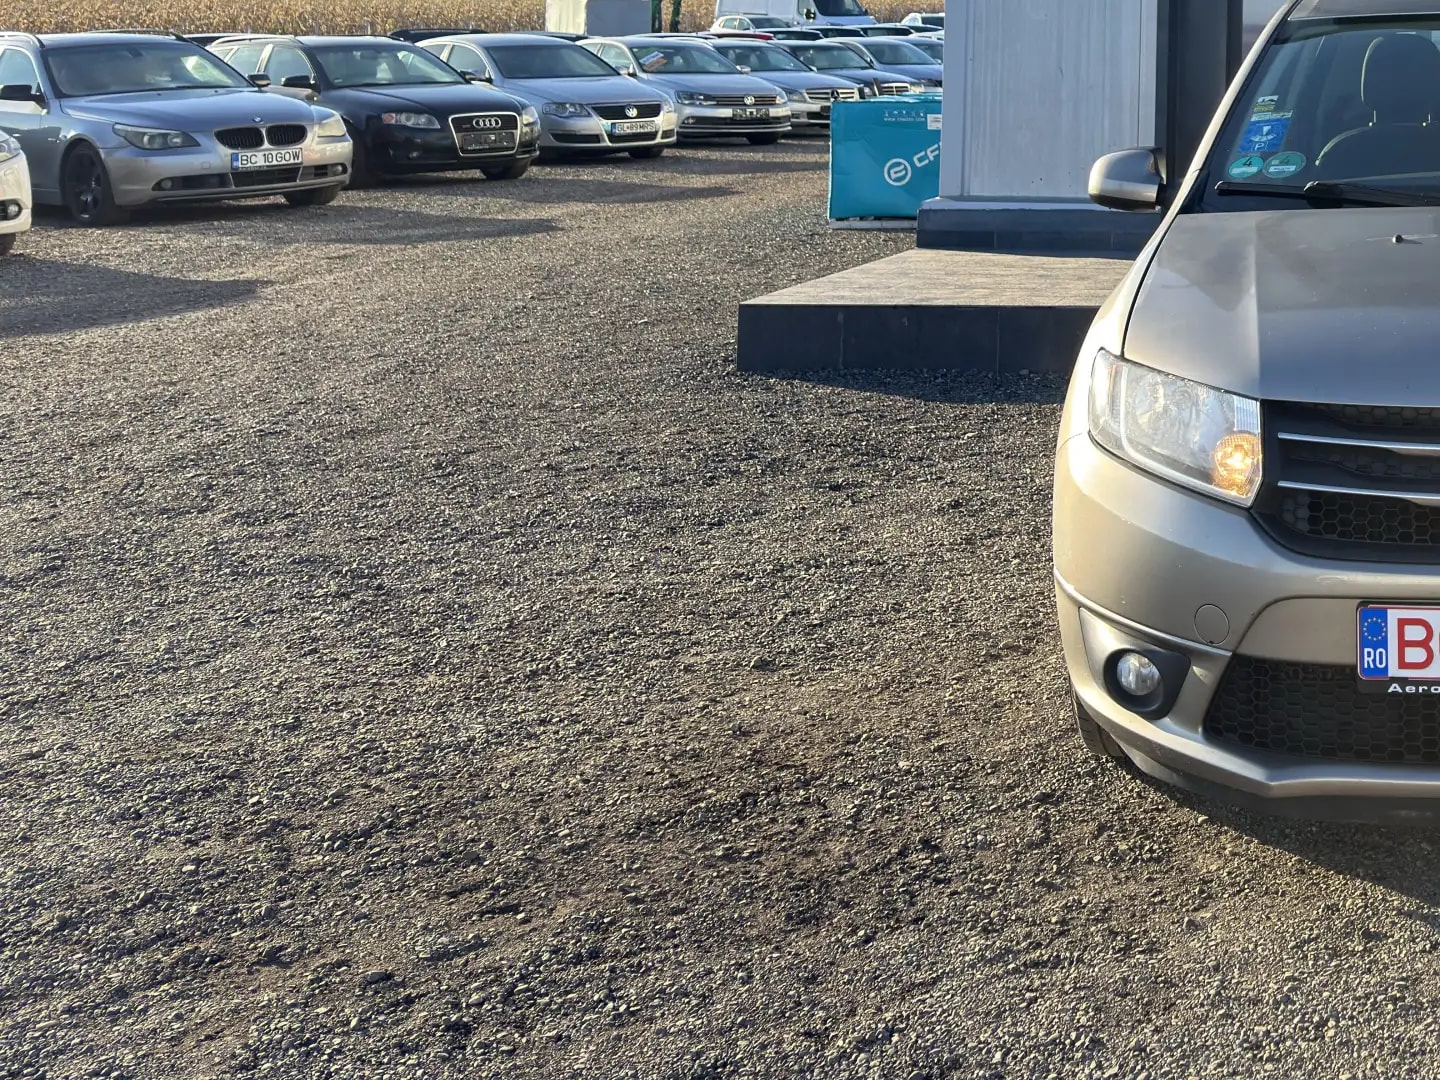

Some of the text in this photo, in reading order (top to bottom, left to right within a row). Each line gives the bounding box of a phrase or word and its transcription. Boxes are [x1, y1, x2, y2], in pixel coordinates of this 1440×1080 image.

[240, 154, 258, 166] BC
[262, 152, 274, 164] 10
[275, 150, 301, 163] GOW
[1242, 156, 1253, 167] 4
[1363, 647, 1387, 669] RO
